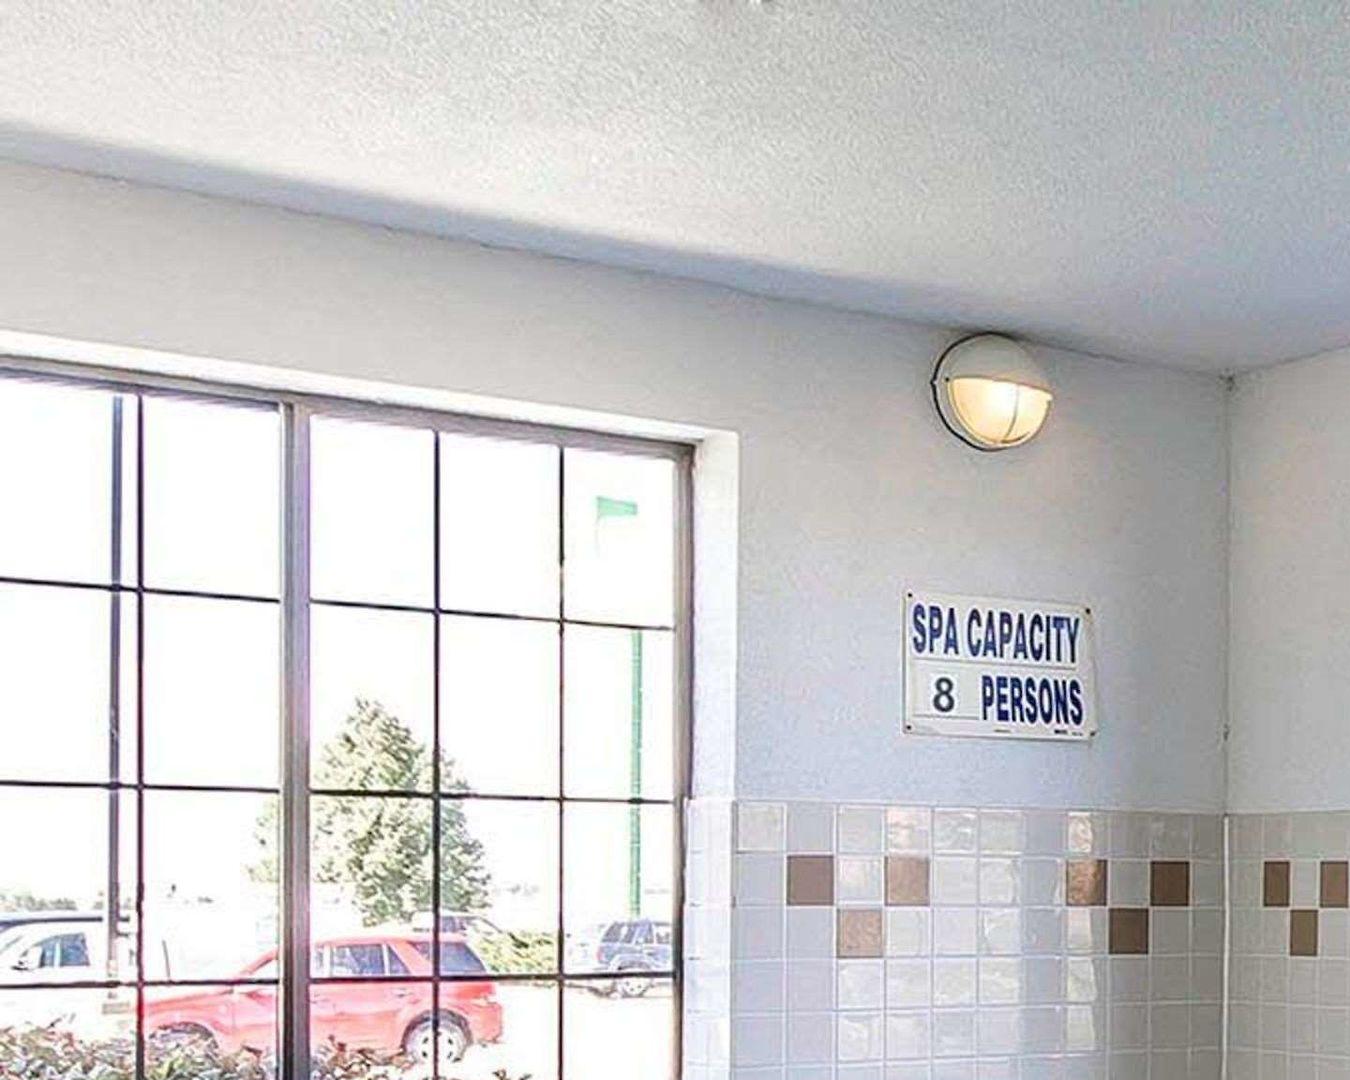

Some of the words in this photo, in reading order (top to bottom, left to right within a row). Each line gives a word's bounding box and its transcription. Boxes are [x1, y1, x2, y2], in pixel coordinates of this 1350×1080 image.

[912, 603, 959, 655] SPA
[967, 608, 1080, 663] CAPACITY
[932, 677, 955, 713] 8
[981, 674, 1083, 726] PERSONS
